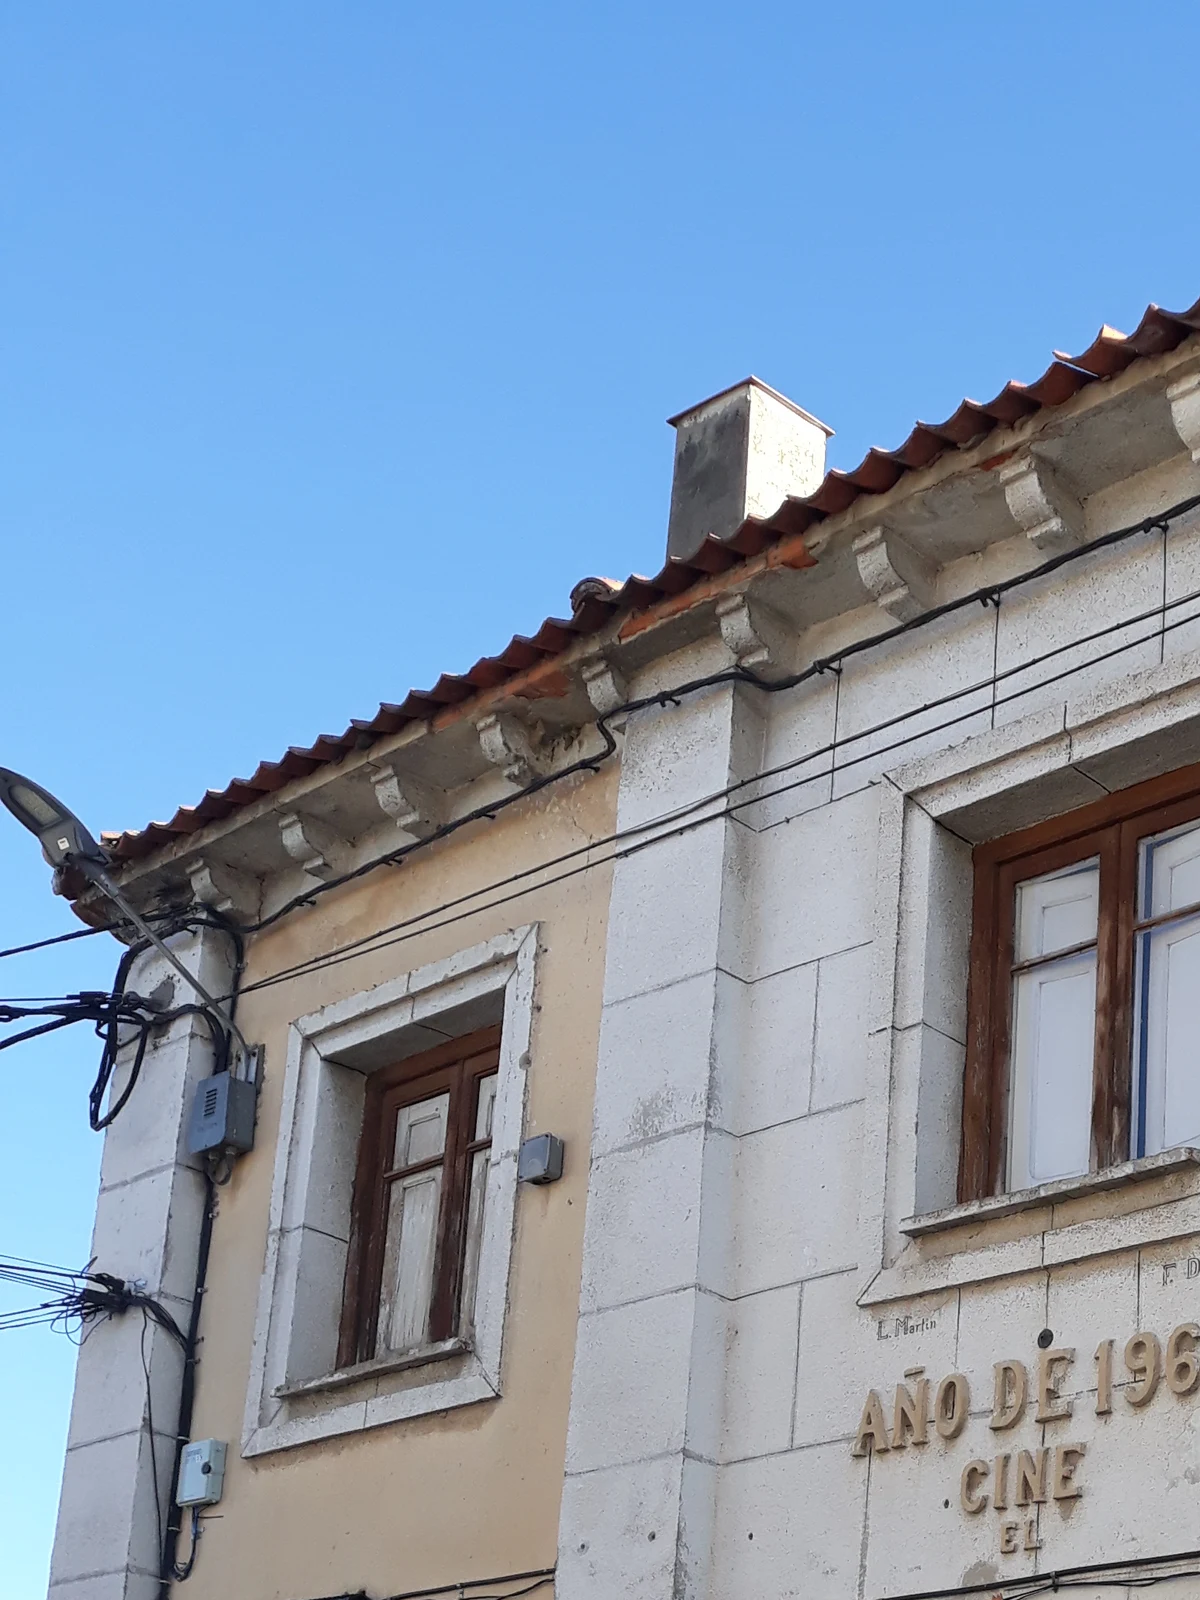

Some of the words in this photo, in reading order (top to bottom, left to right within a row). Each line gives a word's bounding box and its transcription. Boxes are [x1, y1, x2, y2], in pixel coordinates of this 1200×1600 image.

[851, 1366, 970, 1458] AÑO
[989, 1347, 1076, 1431] DE
[960, 1441, 1087, 1514] CINE
[999, 1519, 1042, 1554] EL
